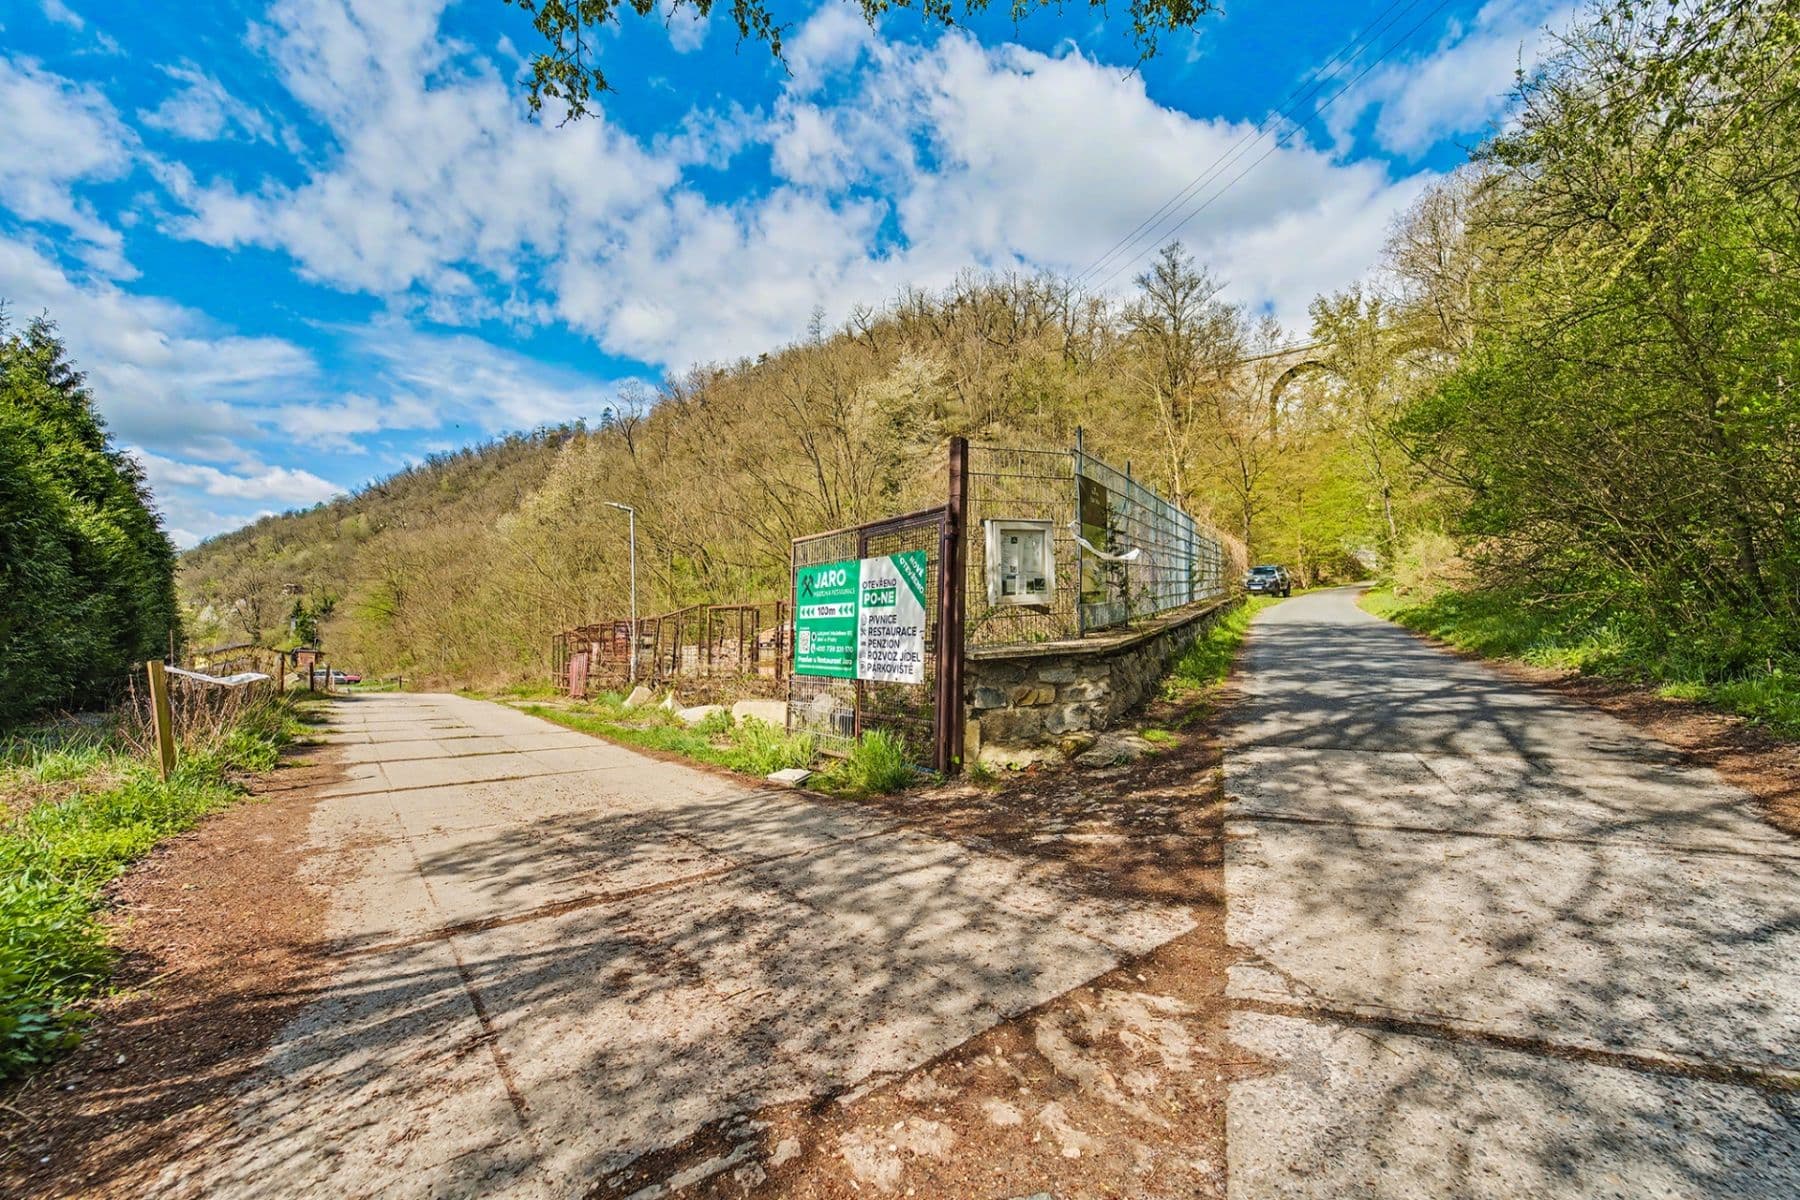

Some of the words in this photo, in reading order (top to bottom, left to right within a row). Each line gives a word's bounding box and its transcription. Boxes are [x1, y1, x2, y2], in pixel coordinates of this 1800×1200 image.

[814, 569, 846, 589] JARO
[862, 577, 897, 589] OTEVŘENO
[863, 591, 895, 605] PO-NE
[817, 606, 836, 616] 100m
[868, 614, 897, 624] PIVNICE
[868, 626, 917, 636] RESTAURACE
[867, 639, 900, 649] PENZION
[867, 651, 898, 661] ROZVOZ
[899, 649, 921, 662] JÍDEL
[866, 662, 914, 675] PARKOVIŠTĚ
